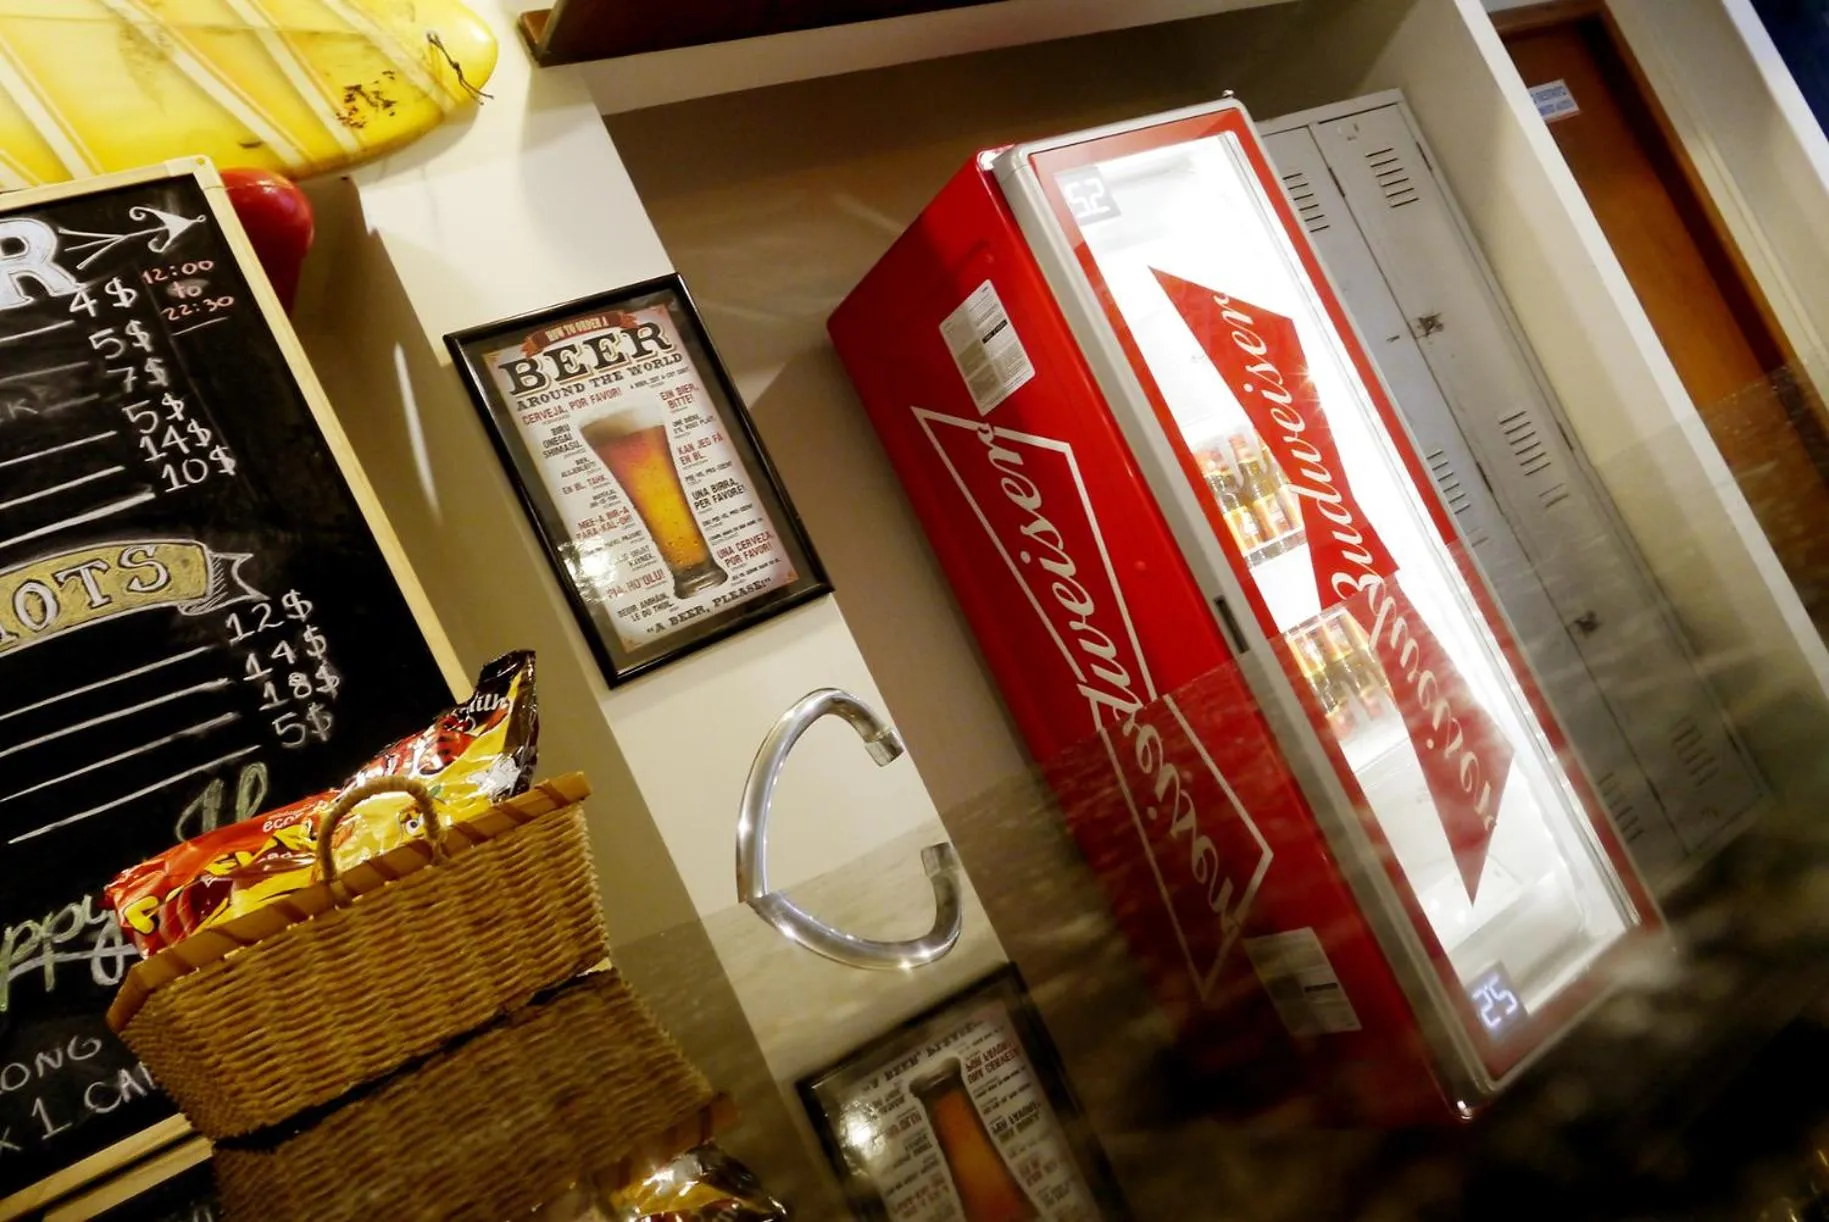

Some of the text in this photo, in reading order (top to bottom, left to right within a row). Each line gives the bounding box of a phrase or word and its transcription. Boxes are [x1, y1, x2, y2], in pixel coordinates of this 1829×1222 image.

[142, 259, 215, 285] 12:00
[170, 281, 204, 299] to
[163, 294, 235, 322] 22:30
[499, 321, 673, 396] BEER
[515, 382, 586, 411] AROUND
[589, 370, 623, 388] THE
[624, 352, 683, 377] WORLD
[568, 398, 588, 410] POR
[0, 545, 171, 646] OTS
